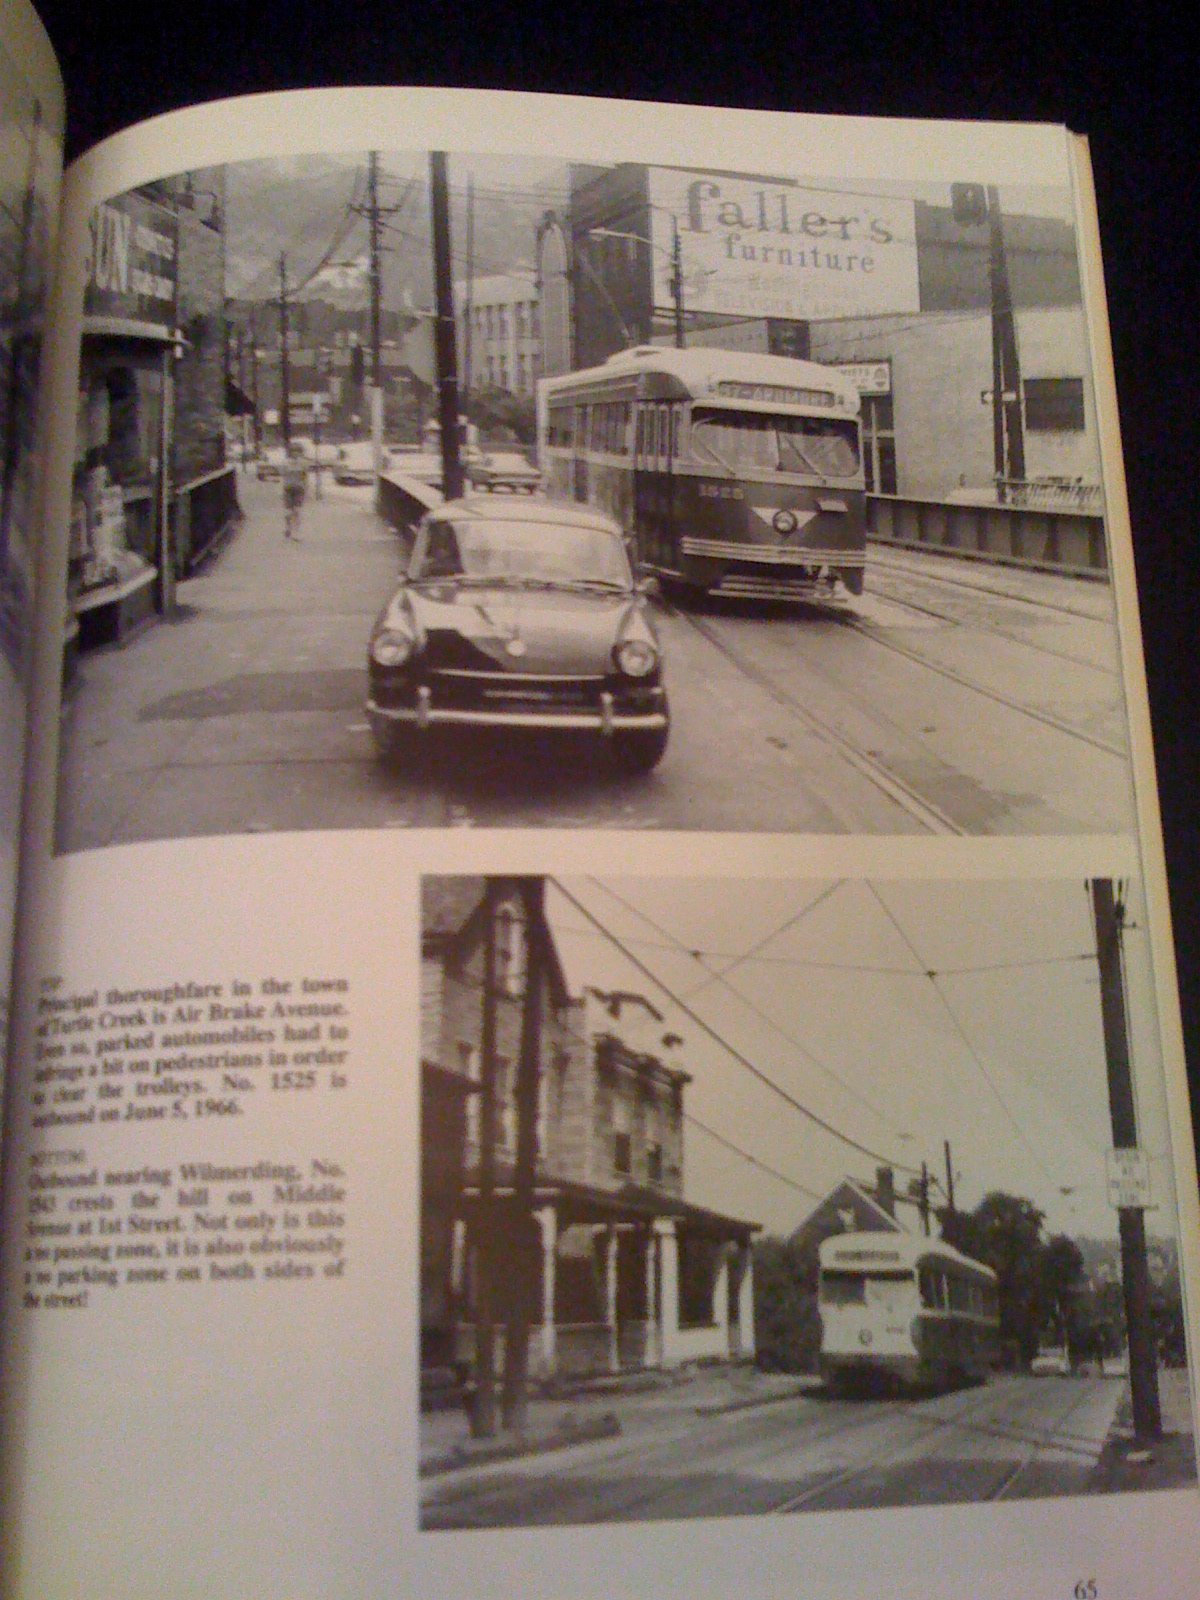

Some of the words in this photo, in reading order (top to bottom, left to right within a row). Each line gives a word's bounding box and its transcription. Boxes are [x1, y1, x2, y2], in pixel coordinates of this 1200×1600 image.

[681, 180, 893, 244] faller's
[723, 233, 875, 274] furniture
[106, 980, 222, 1005] thoroughfare
[232, 979, 251, 996] in
[260, 977, 292, 994] the
[302, 977, 348, 993] town
[99, 1010, 147, 1029] Creek
[151, 1006, 167, 1025] is
[172, 1004, 202, 1024] Air
[209, 1002, 266, 1021] Brake
[271, 1002, 348, 1018] Avenue.
[96, 1031, 155, 1058] parked
[160, 1025, 275, 1048] automobiles
[284, 1023, 320, 1042] had
[329, 1023, 348, 1041] to
[129, 1059, 150, 1074] on
[154, 1052, 263, 1077] pedestrians
[268, 1049, 288, 1066] in
[293, 1046, 348, 1065] order
[97, 1081, 122, 1099] the
[136, 1075, 208, 1098] trolleys.
[222, 1071, 256, 1091] No.
[270, 1065, 317, 1090] 1525
[330, 1069, 347, 1087] is
[100, 1107, 121, 1123] on
[124, 1101, 167, 1121] June
[172, 1098, 188, 1120] 5,
[195, 1098, 244, 1118] 1966.
[104, 1164, 172, 1189] nearing
[179, 1159, 302, 1183] Wilmerding,
[310, 1157, 346, 1178] No.
[131, 1189, 160, 1209] the
[177, 1186, 209, 1206] hill
[228, 1189, 253, 1205] on
[272, 1182, 347, 1203] Middle
[127, 1213, 188, 1234] Street.
[193, 1211, 228, 1231] Not
[234, 1211, 276, 1235] only
[283, 1210, 299, 1228] is
[307, 1208, 346, 1229] this
[53, 1243, 111, 1266] passing
[165, 1238, 181, 1258] it
[184, 1238, 200, 1258] is
[206, 1234, 244, 1256] also
[248, 1232, 344, 1259] obviously
[57, 1264, 119, 1290] parking
[126, 1267, 168, 1284] zone
[175, 1266, 200, 1283] on
[209, 1260, 255, 1281] both
[262, 1257, 315, 1280] sides
[323, 1256, 347, 1279] of
[1074, 1578, 1097, 1600] 65
